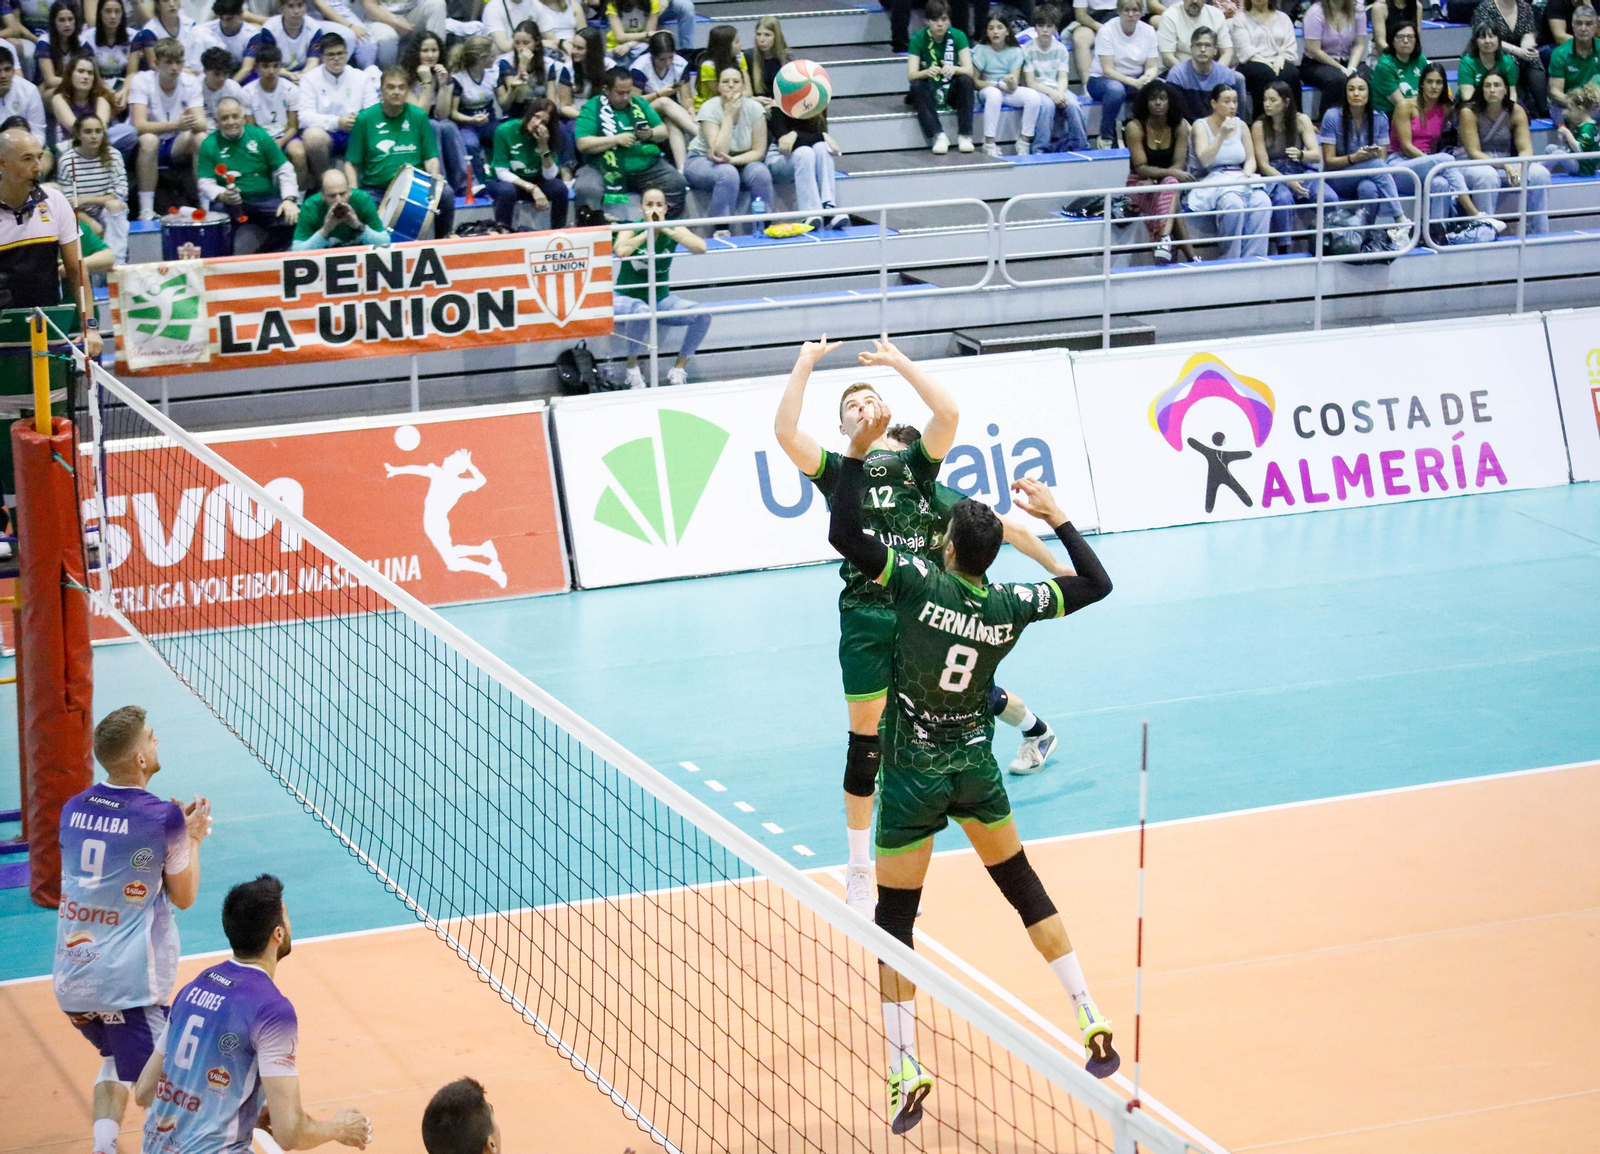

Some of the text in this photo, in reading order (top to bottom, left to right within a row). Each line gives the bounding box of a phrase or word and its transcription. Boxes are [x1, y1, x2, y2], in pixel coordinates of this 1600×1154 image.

[283, 243, 448, 299] PEÑA
[534, 261, 586, 273] LA UNION
[219, 289, 515, 354] LA UNION
[1293, 389, 1493, 439] COSTA DE
[1261, 430, 1508, 509] ALMERÍA
[868, 485, 896, 509] 12
[189, 569, 295, 606] VOLEIBOL
[918, 600, 1014, 646] FERNÁNDEZ
[939, 643, 979, 693] 8
[69, 811, 129, 835] VILLALBA
[78, 838, 107, 889] 9
[185, 986, 226, 1012] FLORES
[174, 1014, 205, 1071] 6
